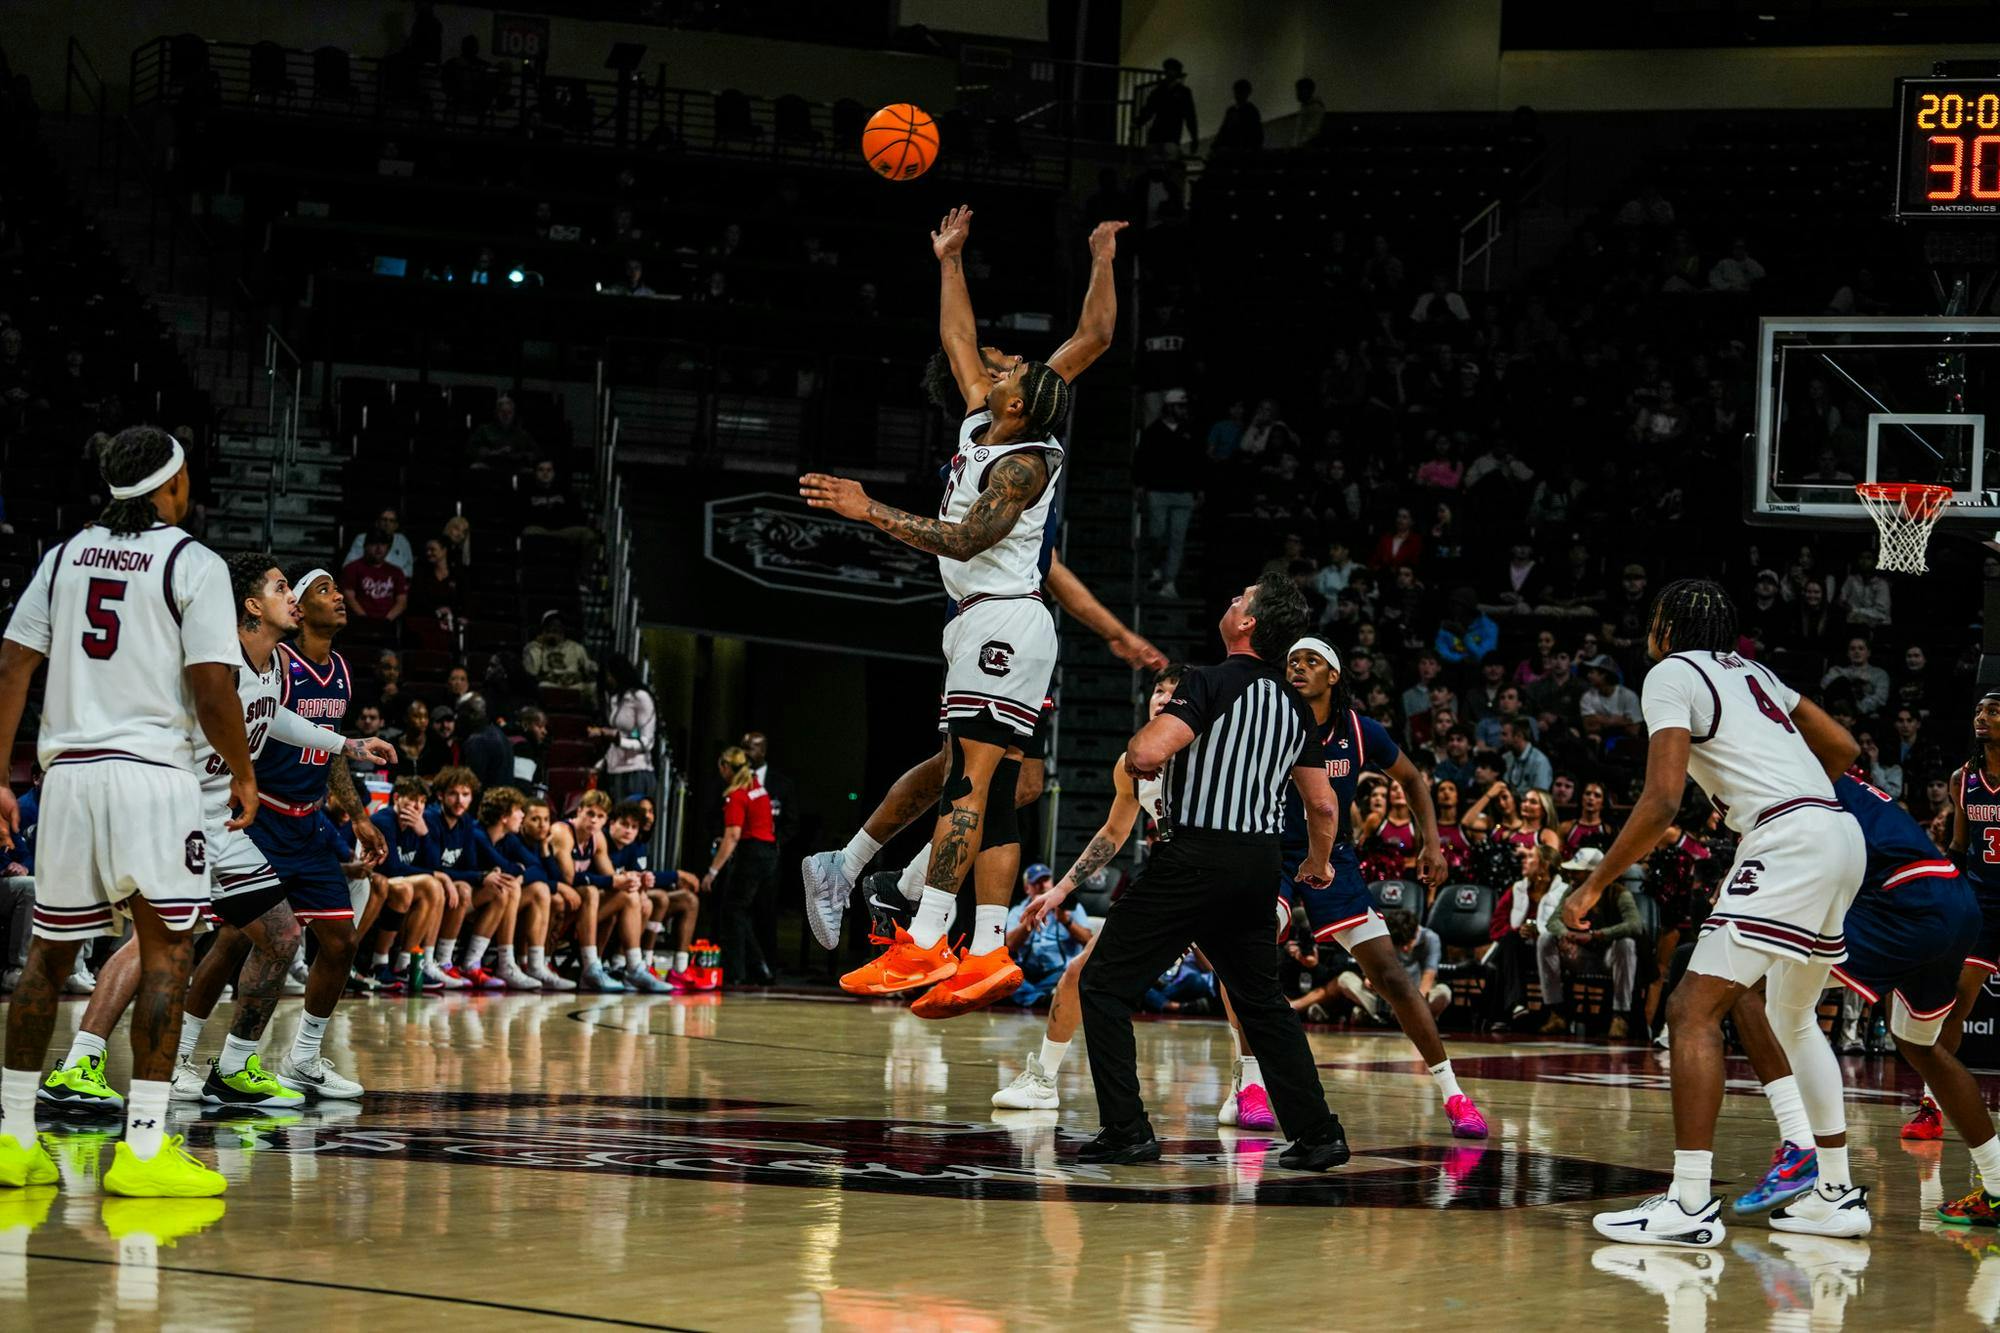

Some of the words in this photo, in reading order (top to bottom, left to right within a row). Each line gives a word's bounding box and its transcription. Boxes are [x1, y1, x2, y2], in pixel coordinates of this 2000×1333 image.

[73, 547, 154, 572] JOHNSON
[81, 576, 128, 661] 5
[297, 698, 346, 718] RADFORD
[1744, 674, 1796, 734] 4
